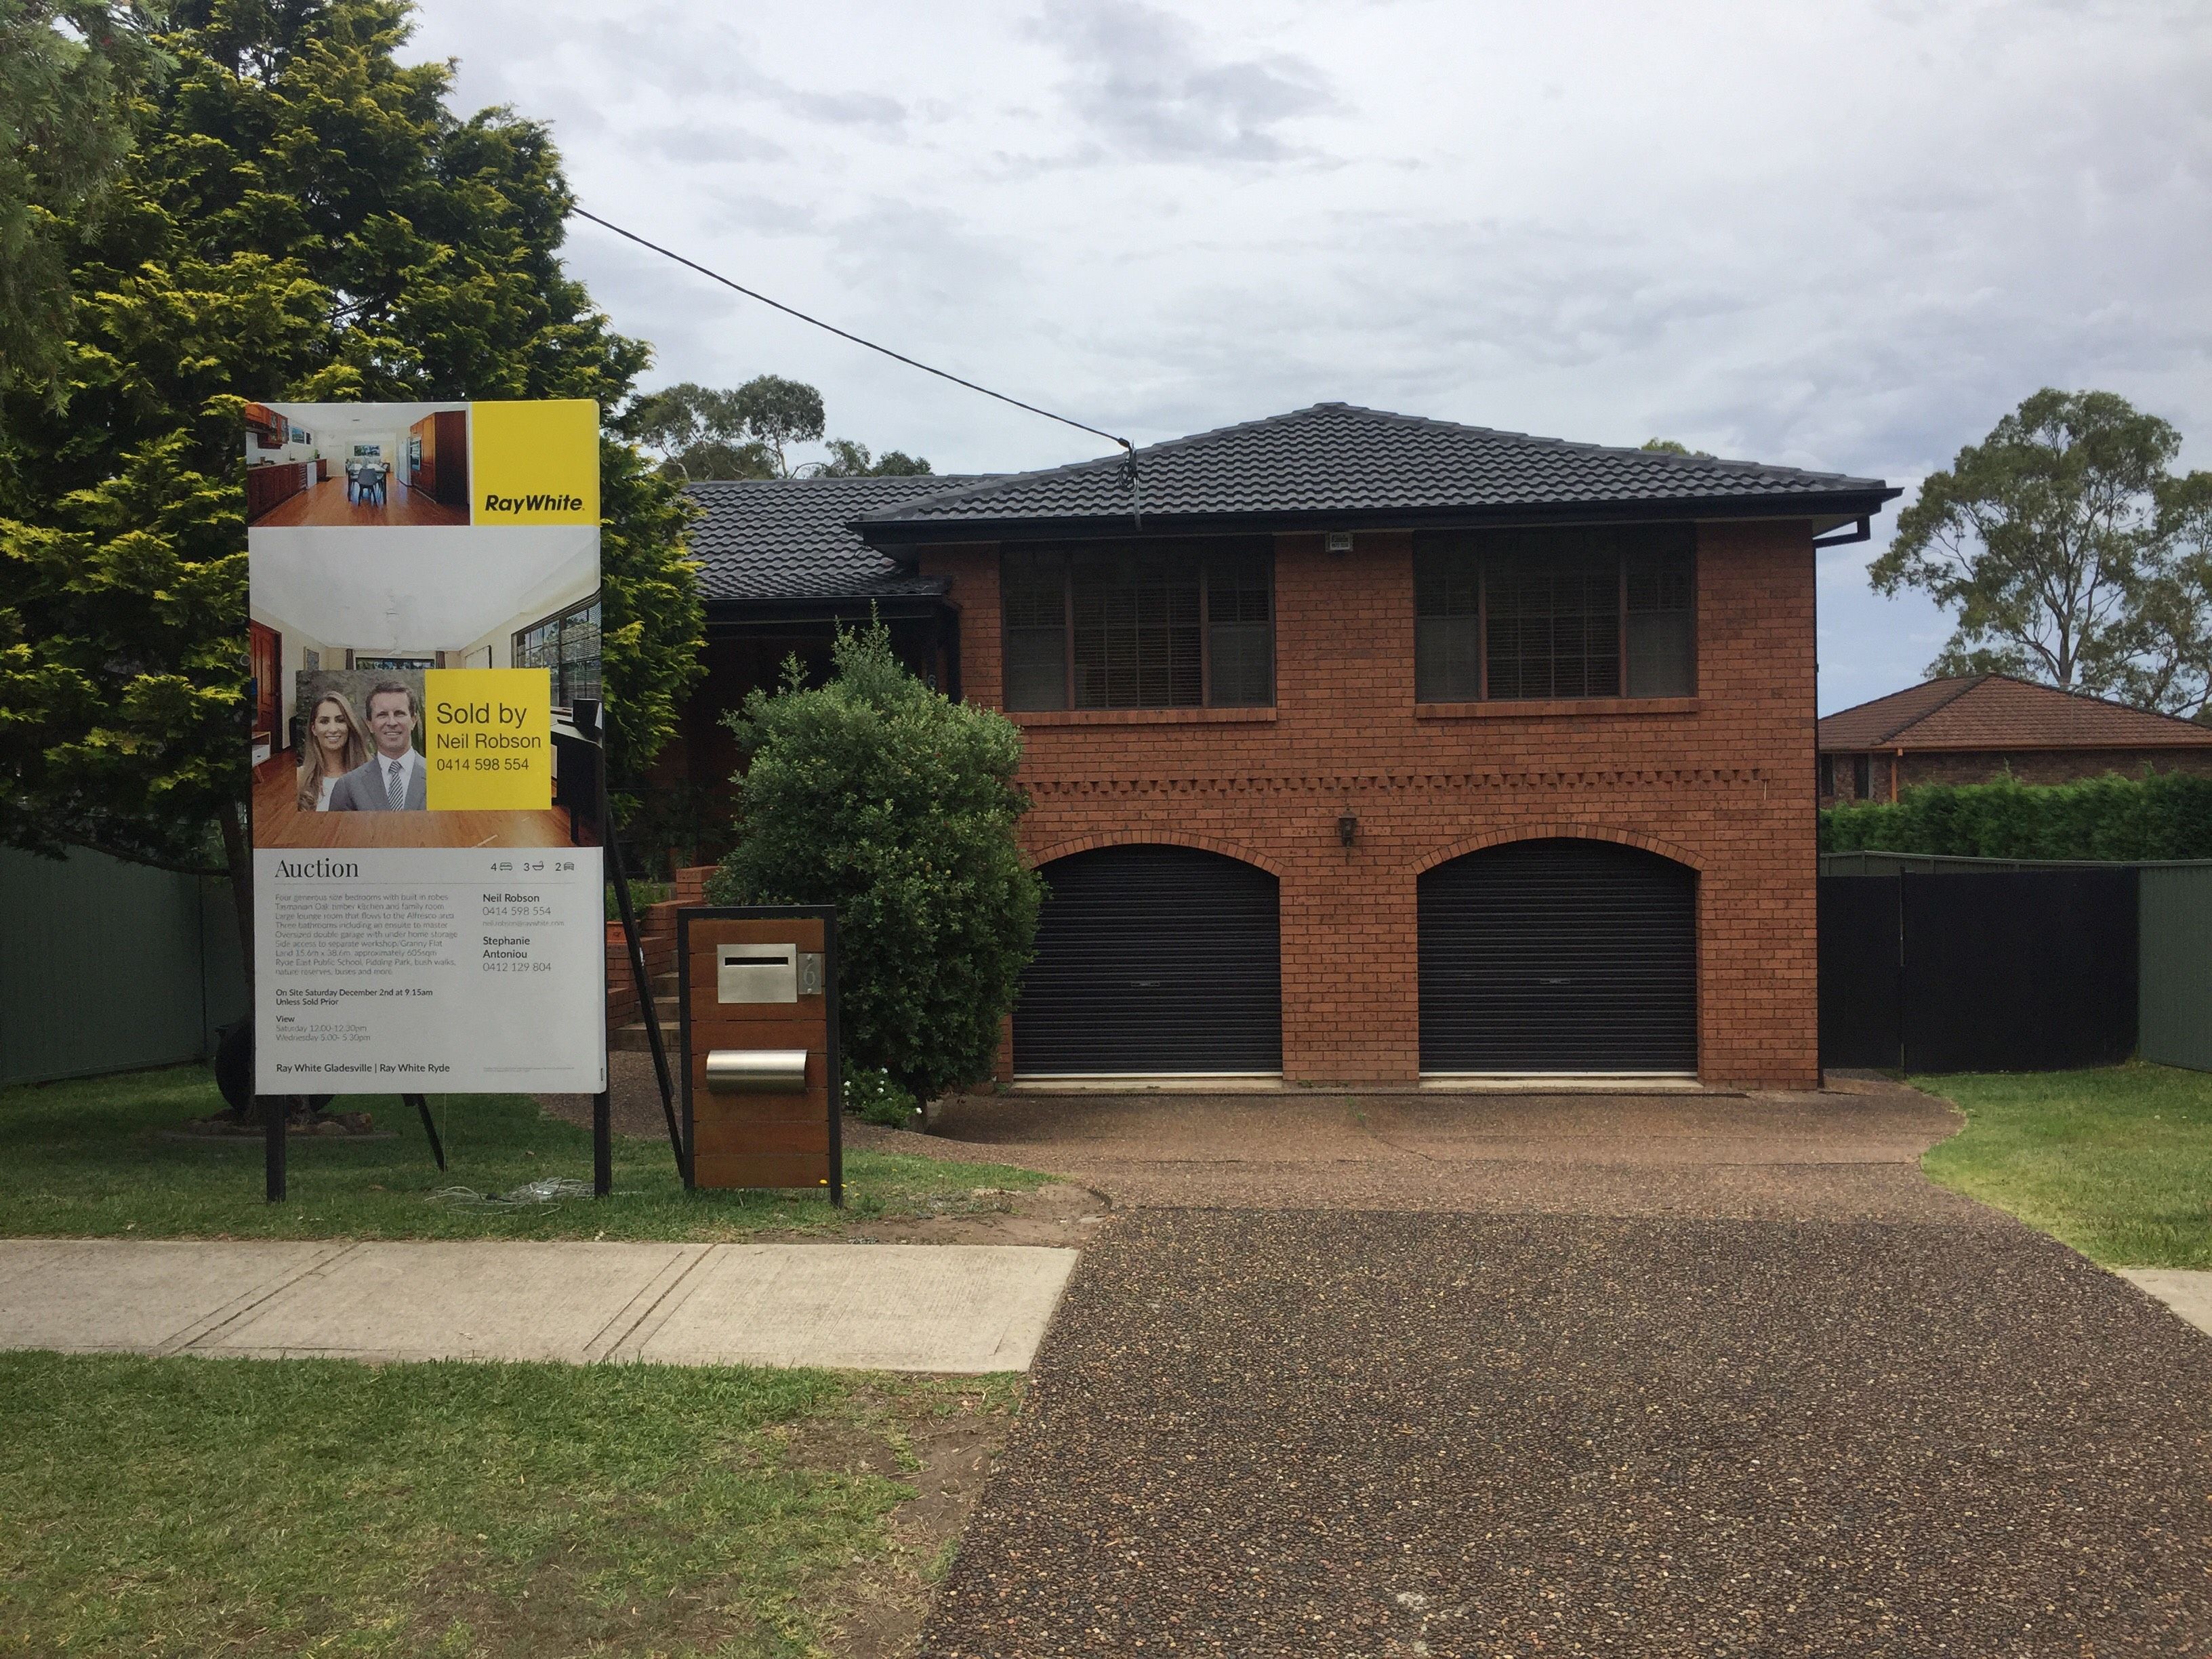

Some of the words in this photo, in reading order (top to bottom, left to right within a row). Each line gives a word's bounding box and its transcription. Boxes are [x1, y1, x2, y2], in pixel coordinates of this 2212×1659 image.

[436, 702, 489, 724] Sold
[499, 702, 527, 729] by
[437, 733, 469, 749] Neil
[475, 733, 541, 749] Robson
[436, 758, 470, 771] 0414
[475, 758, 500, 771] 598
[504, 758, 529, 771] 554
[274, 857, 359, 878] Auction
[491, 863, 497, 872] 4
[523, 863, 530, 872] 3
[555, 863, 561, 872] 2
[275, 894, 291, 902] Four
[293, 894, 327, 902] generous
[345, 894, 381, 902] bedrooms
[383, 894, 398, 902] with
[401, 894, 417, 902] built
[419, 894, 426, 902] in
[428, 894, 449, 902] robes
[483, 894, 501, 902] Neil
[505, 894, 539, 902] Robson
[275, 912, 294, 920] Large
[297, 912, 321, 920] lounge
[483, 907, 507, 916] 0414
[511, 907, 529, 916] 598
[533, 907, 550, 916] 554
[328, 941, 359, 949] separate
[483, 936, 530, 946] Stephanie
[483, 949, 527, 958] Antoniou
[483, 962, 508, 971] 0412
[512, 962, 530, 971] 129
[533, 962, 552, 971] 804
[306, 989, 337, 997] Saturday
[276, 1064, 293, 1073] Ray
[295, 1064, 321, 1072] White
[325, 1064, 373, 1072] Gladesville
[380, 1064, 396, 1073] Ray
[398, 1063, 426, 1072] White
[428, 1064, 450, 1073] Ryde
